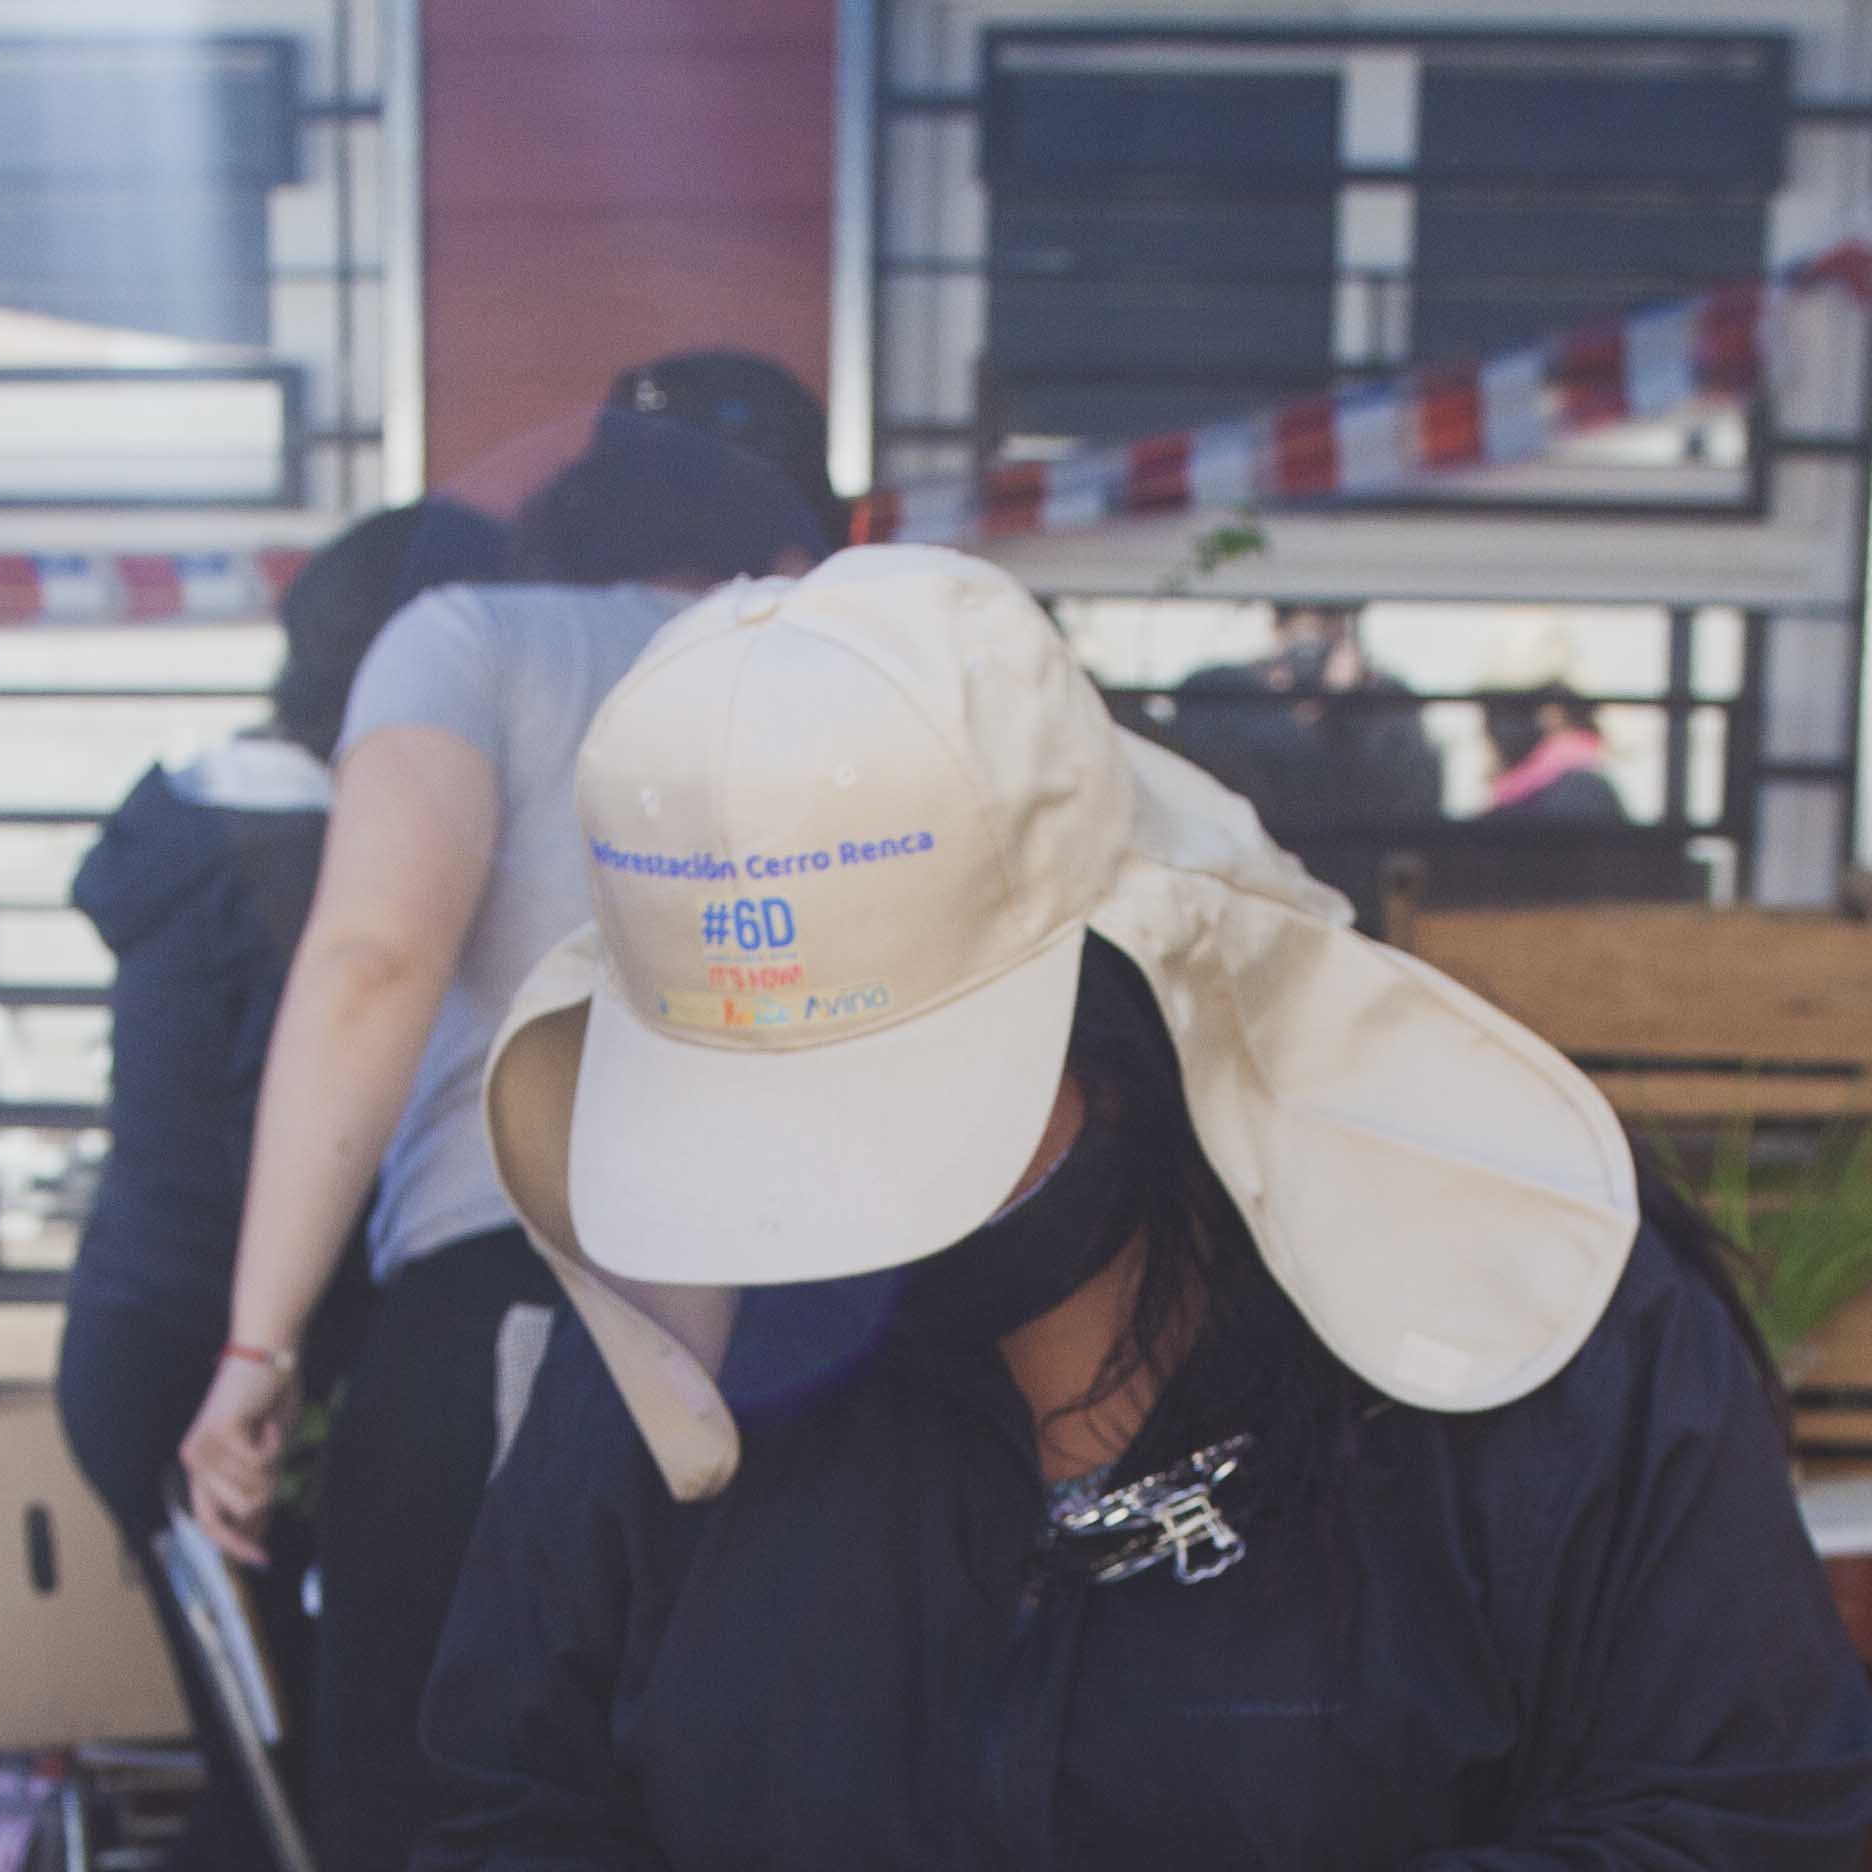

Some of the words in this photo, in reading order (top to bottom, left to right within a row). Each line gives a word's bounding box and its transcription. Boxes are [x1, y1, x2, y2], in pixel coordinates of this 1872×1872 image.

[745, 850, 830, 880] Cerro
[839, 831, 934, 865] Renca
[702, 897, 797, 951] #6D
